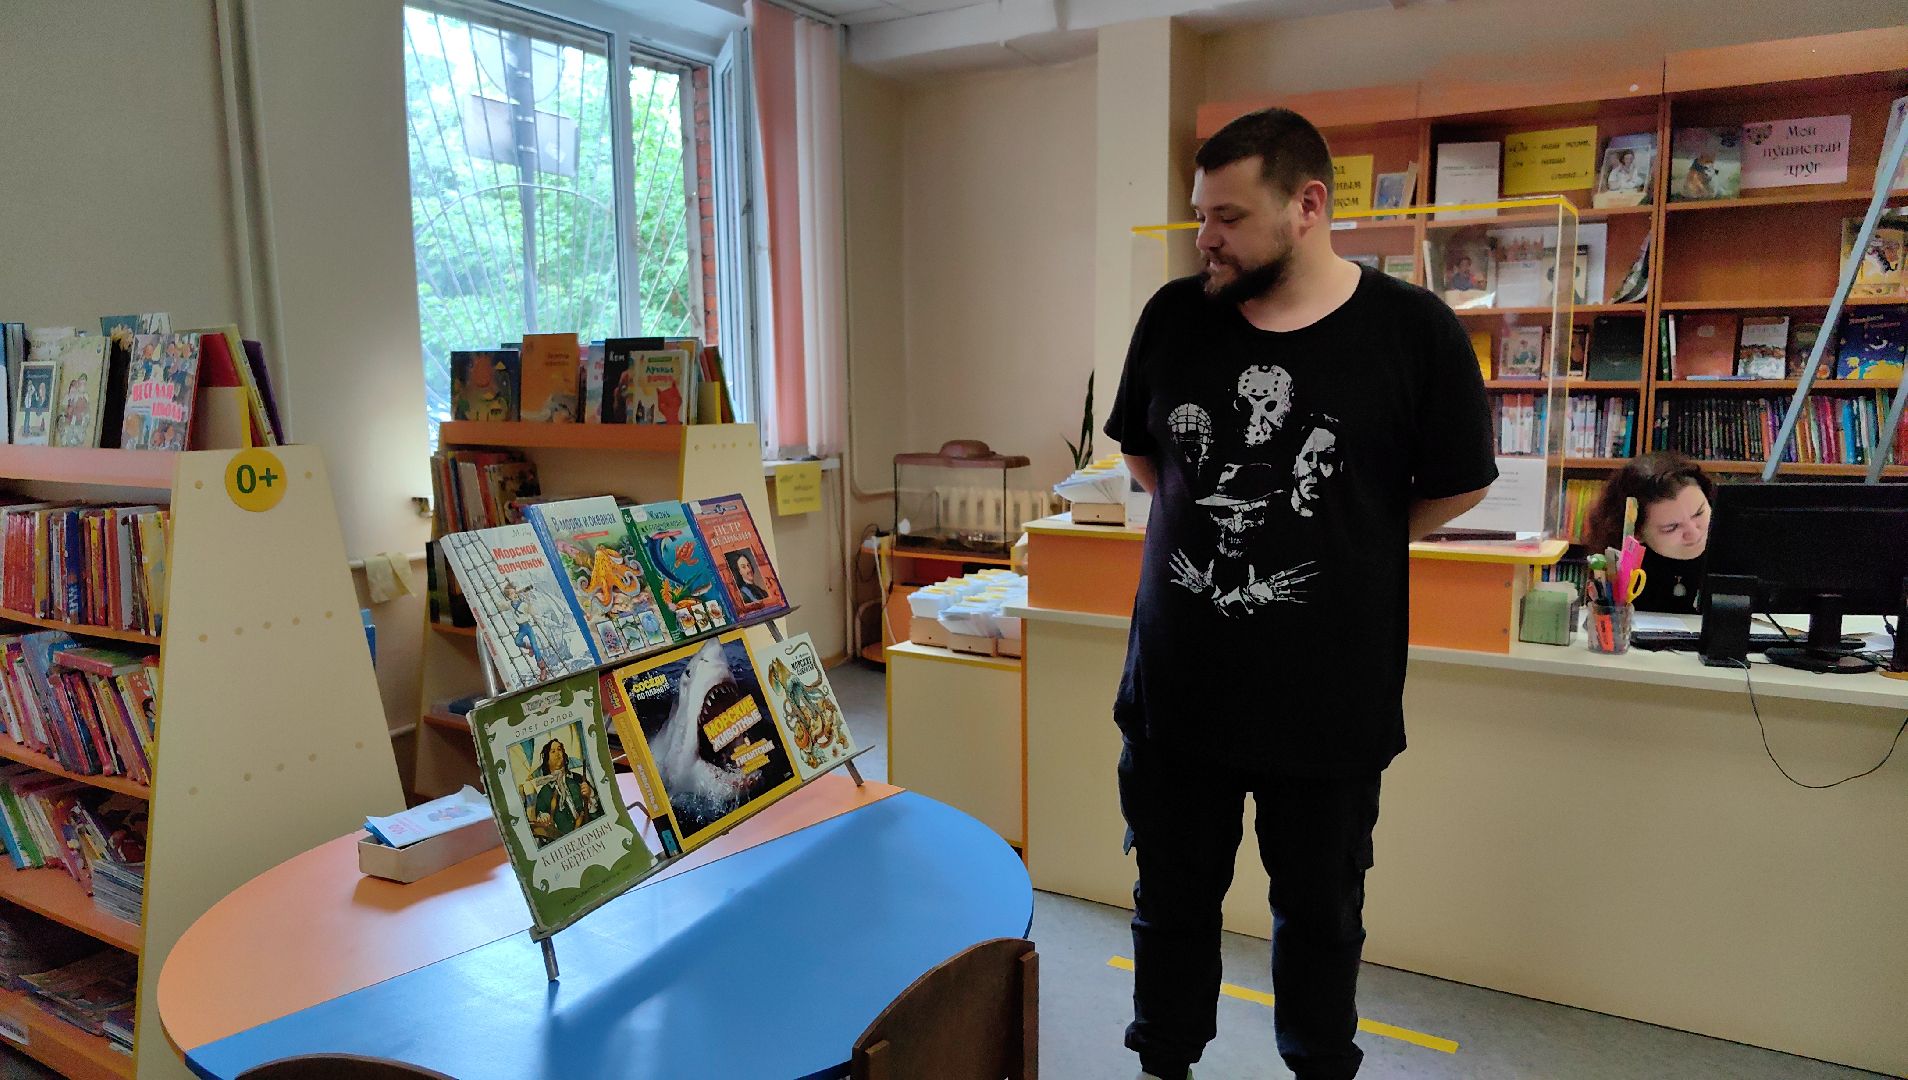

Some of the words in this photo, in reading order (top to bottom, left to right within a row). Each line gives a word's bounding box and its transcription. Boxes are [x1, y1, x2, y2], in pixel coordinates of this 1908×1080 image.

[1787, 126, 1816, 138] Мой
[1763, 141, 1841, 160] пушистый
[1784, 161, 1820, 177] друг
[236, 464, 279, 494] 0+
[551, 516, 560, 532] В
[588, 512, 617, 527] океанах
[632, 673, 668, 694] СОСЕДИ
[515, 722, 539, 739] ОЛЕГ
[543, 710, 576, 728] ОРЛОВ
[702, 693, 759, 742] МОРСКИЕ
[712, 708, 763, 753] ЖИВОТНЫЕ
[541, 854, 552, 868] К
[549, 821, 614, 864] НЕВЕДОМЫМ
[560, 840, 607, 872] БЕРЕГАМ
